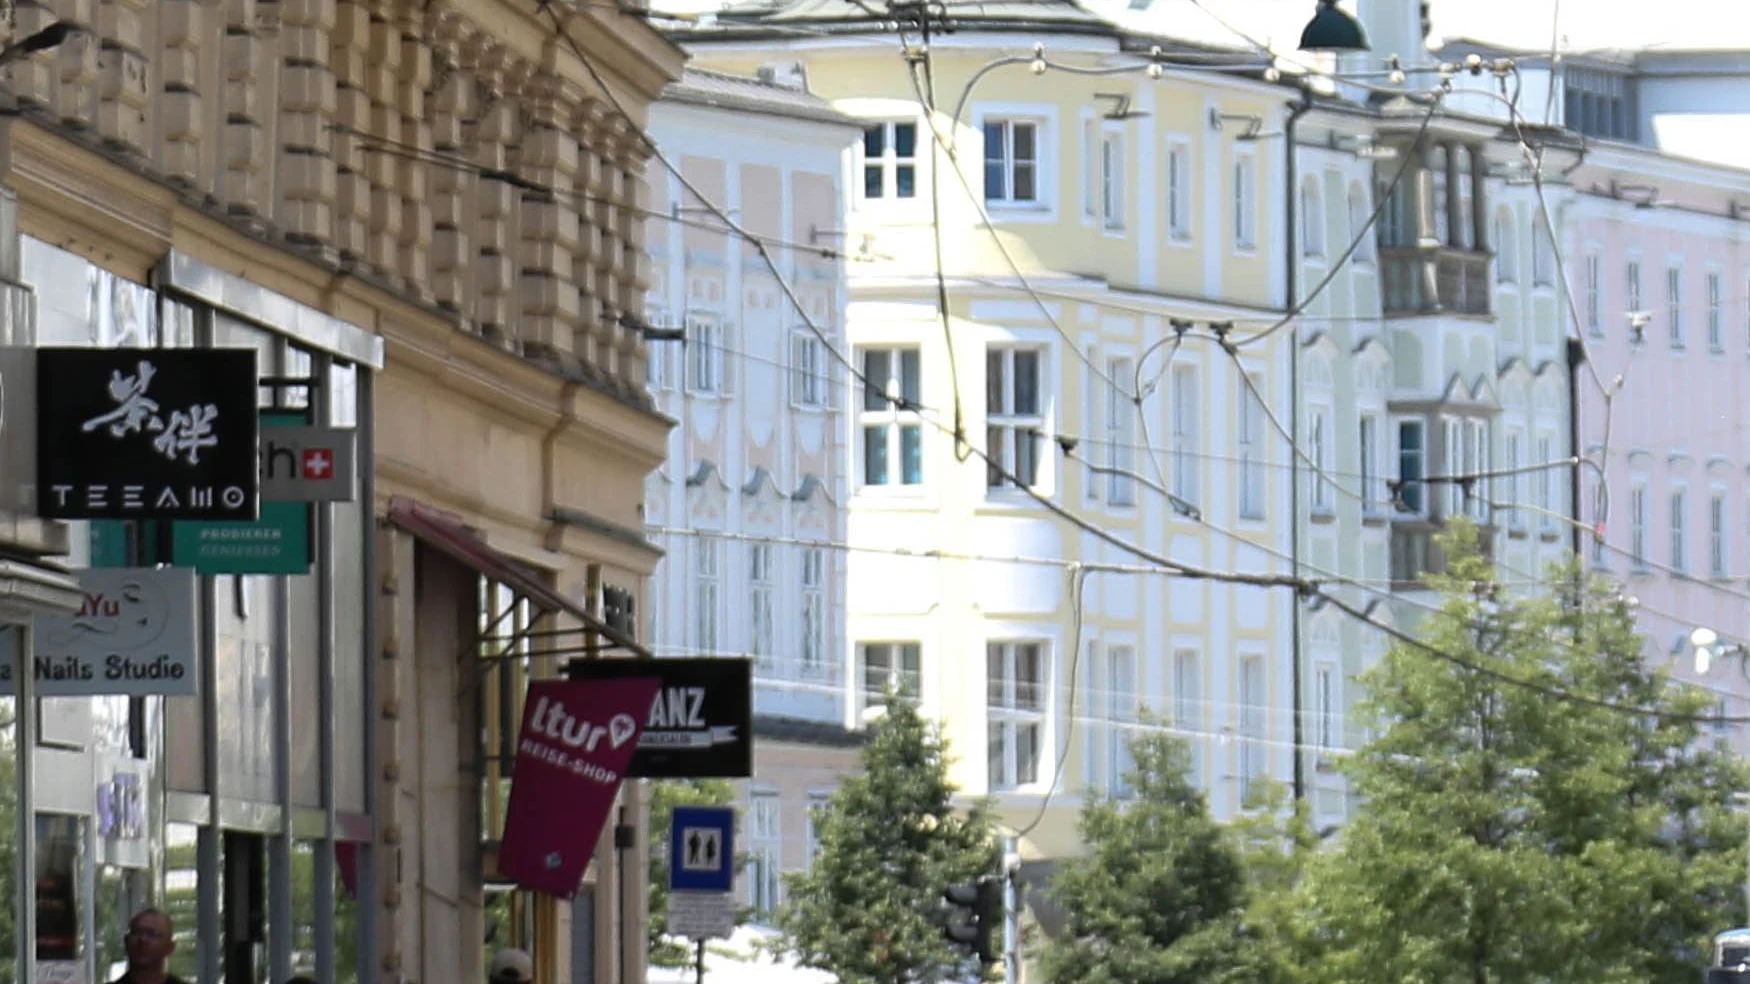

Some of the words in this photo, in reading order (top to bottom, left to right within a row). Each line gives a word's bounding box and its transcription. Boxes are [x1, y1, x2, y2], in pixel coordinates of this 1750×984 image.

[52, 485, 245, 508] TEEAMO
[34, 655, 94, 680] Nails
[104, 653, 185, 680] Studio
[648, 687, 706, 727] ANZ
[520, 738, 617, 785] REISE-SHOP
